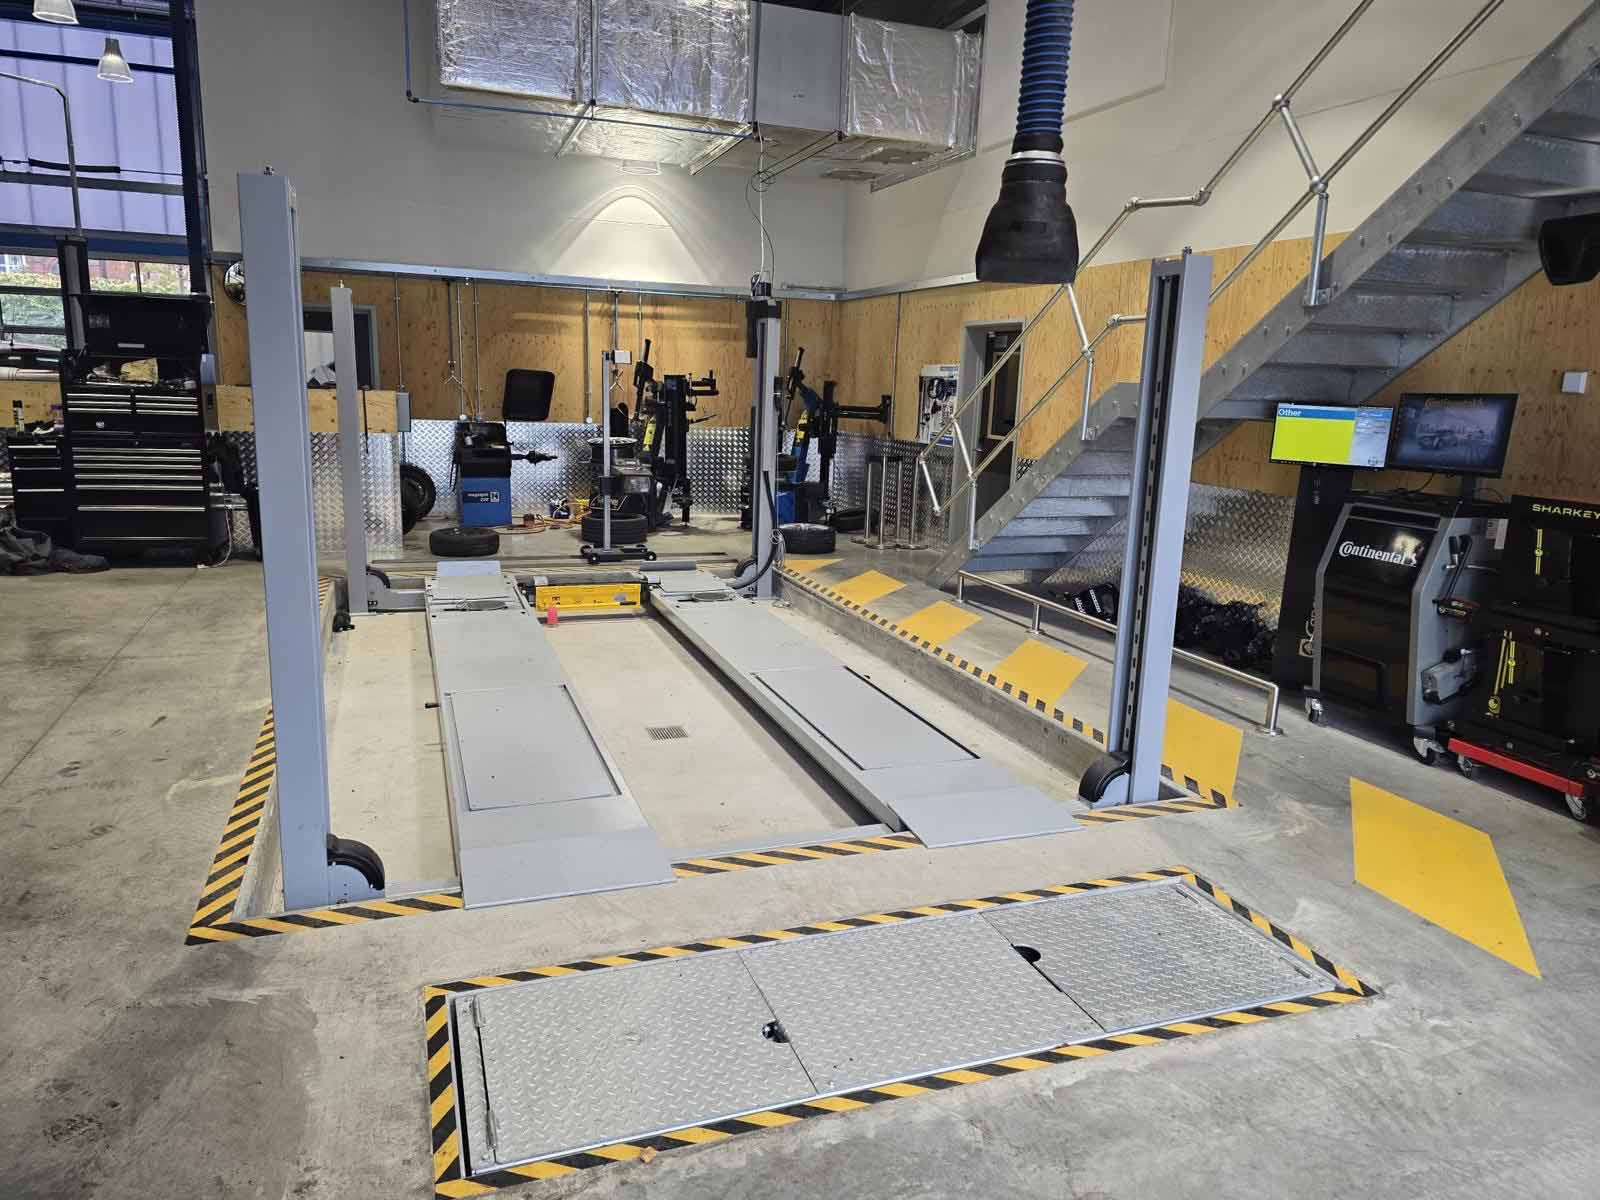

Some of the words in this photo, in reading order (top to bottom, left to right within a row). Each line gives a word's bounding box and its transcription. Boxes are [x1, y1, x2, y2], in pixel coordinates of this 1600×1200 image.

[1279, 408, 1302, 417] Other
[1532, 503, 1600, 519] SHARKEY
[1339, 541, 1406, 566] Continental
